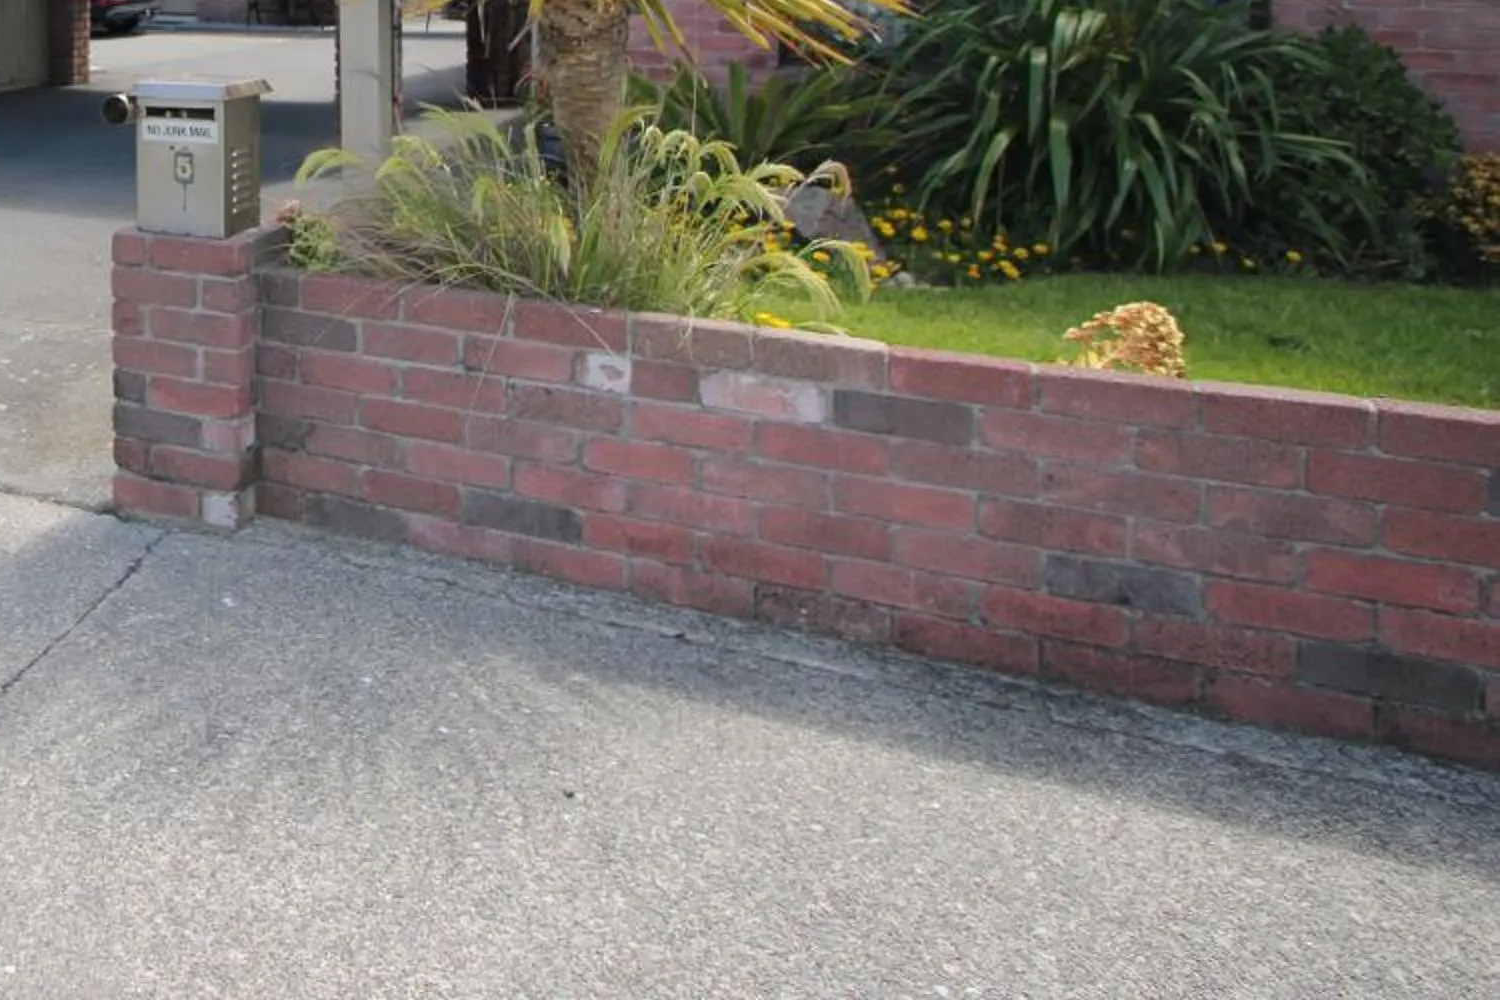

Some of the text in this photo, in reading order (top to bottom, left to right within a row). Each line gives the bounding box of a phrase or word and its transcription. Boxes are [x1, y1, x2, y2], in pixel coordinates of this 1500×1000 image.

[147, 124, 213, 138] NO JUNK MAIL
[176, 156, 192, 179] 5
